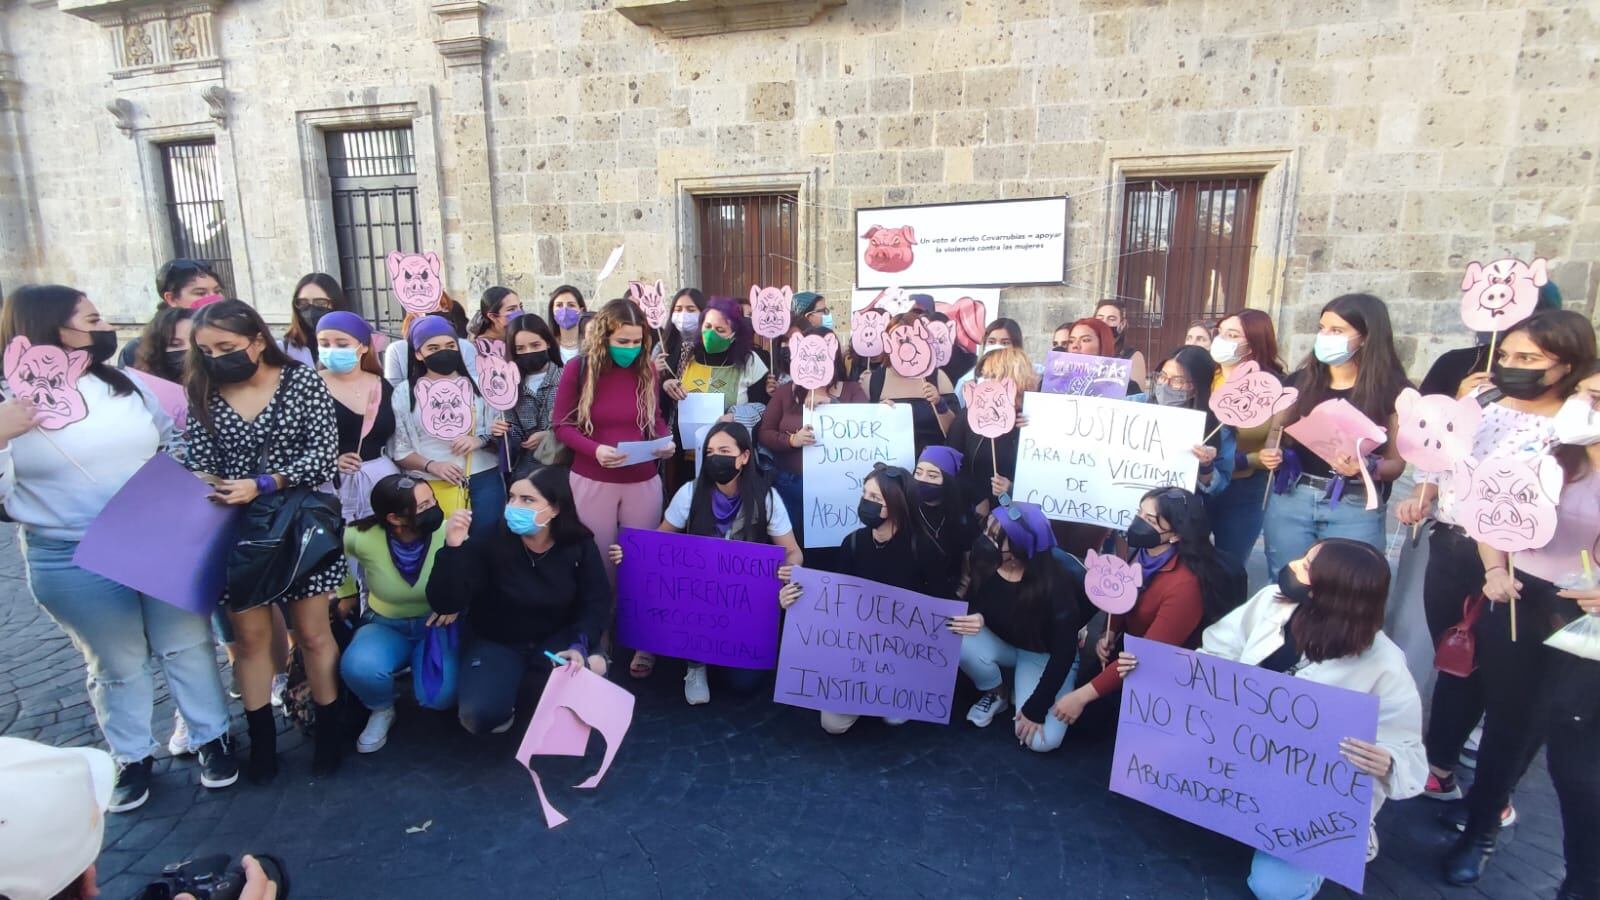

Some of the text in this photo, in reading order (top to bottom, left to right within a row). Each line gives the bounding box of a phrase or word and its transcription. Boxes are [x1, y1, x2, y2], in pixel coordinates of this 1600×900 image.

[981, 234, 1025, 242] Covarrubias
[1035, 232, 1062, 240] apoyar
[820, 415, 890, 442] PODER
[1064, 399, 1164, 460] JUSTICIA
[814, 444, 897, 464] JUDICIAL
[1023, 438, 1060, 462] PARA
[1070, 450, 1096, 468] LAS
[844, 472, 862, 490] SI
[1066, 478, 1088, 493] DE
[811, 496, 861, 528] ABUS
[1027, 490, 1132, 527] COVARRUB
[627, 535, 646, 560] SI
[646, 572, 752, 614] ENFRENTA
[647, 608, 730, 628] PROCESO
[672, 631, 768, 660] JUDICIAL
[796, 623, 948, 668] VIOLENTADORES
[852, 658, 896, 675] DE LAS
[786, 667, 948, 719] INSTITUCIONES
[1175, 652, 1319, 730] JALISCO
[1129, 689, 1369, 804] NO ES COMPLICE
[1127, 752, 1260, 814] ABUSADORES
[1209, 757, 1240, 780] DE
[1255, 811, 1358, 850] SEXUALES
